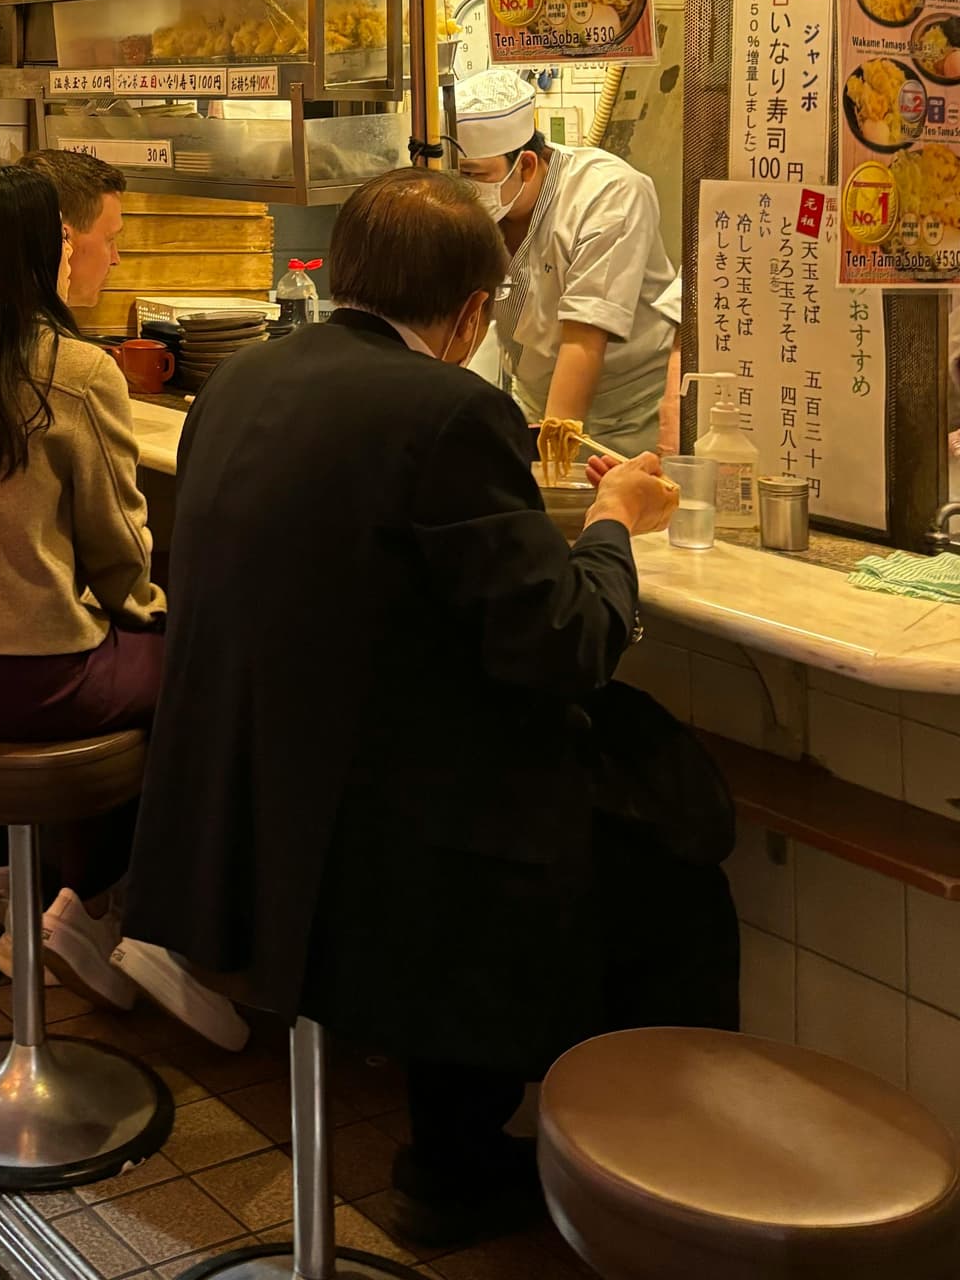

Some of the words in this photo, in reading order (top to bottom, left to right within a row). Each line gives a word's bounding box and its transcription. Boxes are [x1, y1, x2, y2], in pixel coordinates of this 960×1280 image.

[465, 25, 473, 34] 10
[474, 12, 481, 21] 11
[495, 32, 550, 48] Ten-Tama
[552, 30, 579, 45] Soba
[585, 26, 615, 42] ¥530
[851, 36, 880, 48] Wakame
[92, 74, 111, 90] 60円
[800, 23, 820, 112] ジャンボ
[147, 148, 168, 163] 30円
[759, 193, 772, 238] 冷たい
[801, 198, 818, 228] 元祖
[851, 192, 890, 225] No.1
[846, 251, 902, 268] Ten-Tama
[904, 252, 931, 268] Soba
[713, 210, 731, 352] 冷しきつねそば
[735, 214, 753, 337] 冷し天玉そば
[779, 217, 797, 363] とろろ玉子そば
[801, 241, 821, 324] 天玉そば
[780, 385, 798, 478] 四百八十
